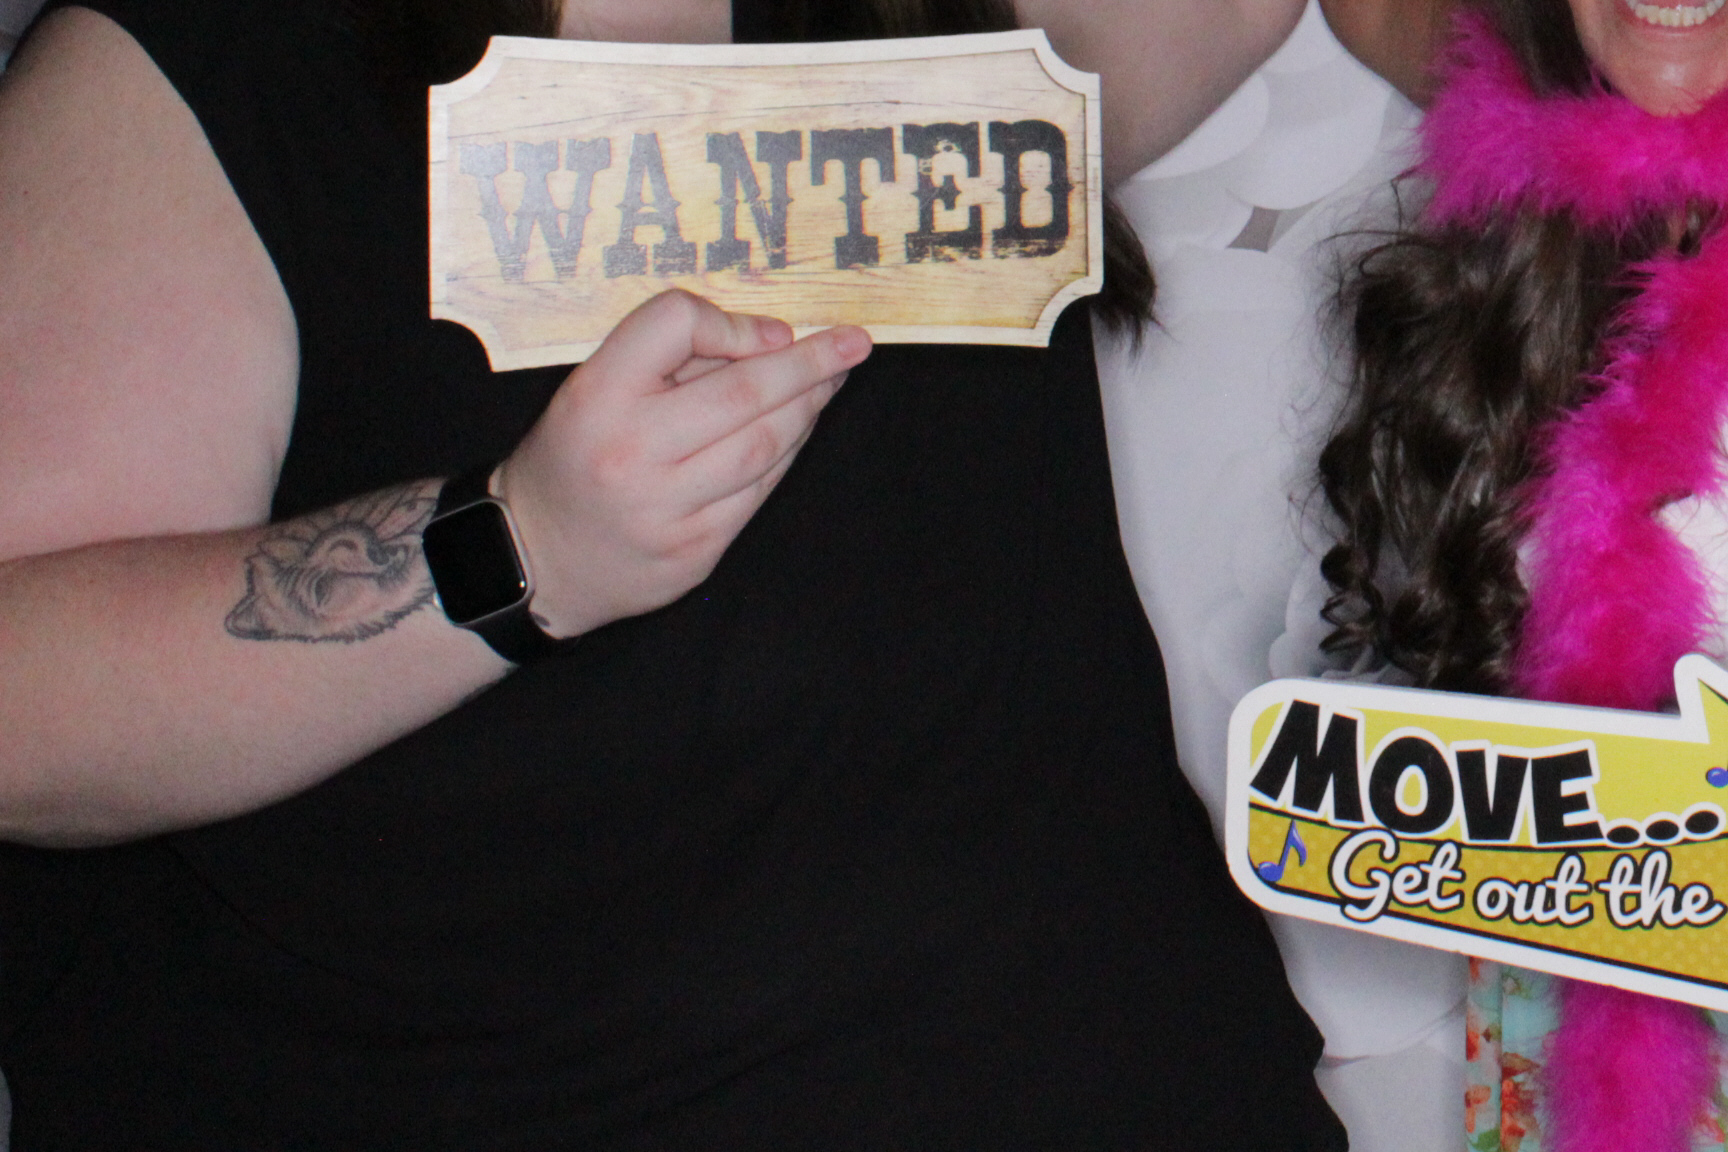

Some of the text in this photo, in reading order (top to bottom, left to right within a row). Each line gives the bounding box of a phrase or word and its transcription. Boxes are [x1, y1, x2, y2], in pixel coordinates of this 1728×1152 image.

[459, 119, 1075, 284] WANTED
[1328, 826, 1466, 923] Get
[1474, 853, 1592, 927] out
[1595, 848, 1727, 928] the
